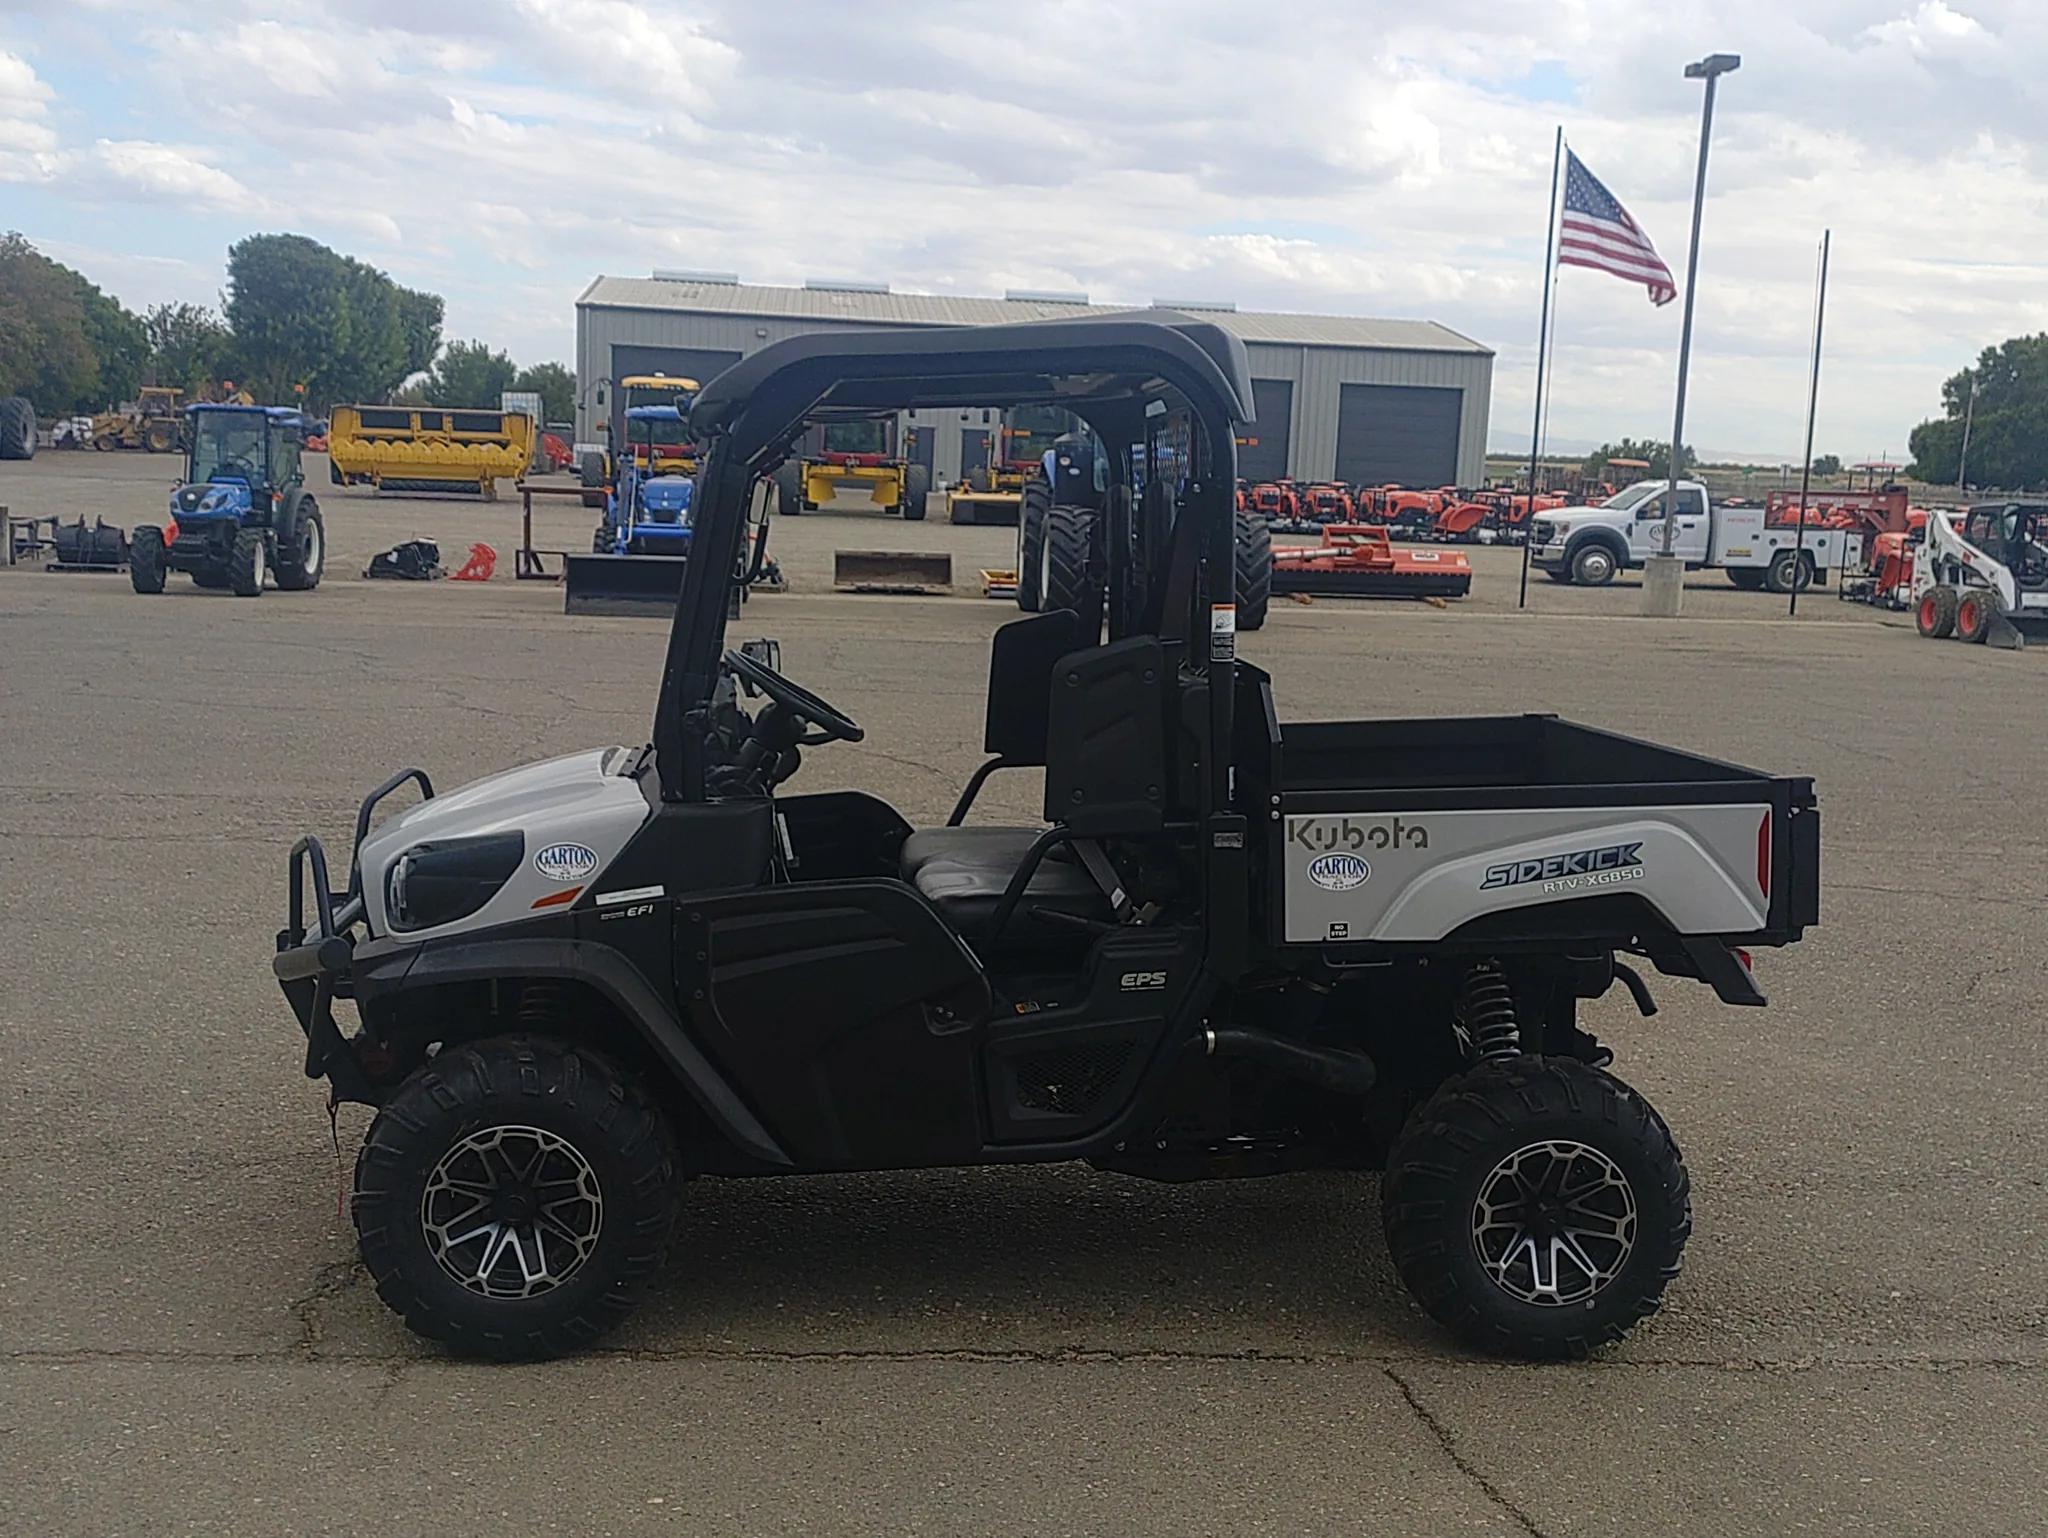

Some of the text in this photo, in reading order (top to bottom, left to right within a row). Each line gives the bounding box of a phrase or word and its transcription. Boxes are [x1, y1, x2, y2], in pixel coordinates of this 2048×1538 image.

[1288, 817, 1428, 850] Kubota
[538, 847, 593, 866] GARTON
[1312, 857, 1365, 875] GARTON
[1480, 842, 1643, 890] SIDEKICK
[626, 903, 654, 917] EFI
[1121, 971, 1167, 987] EPS
